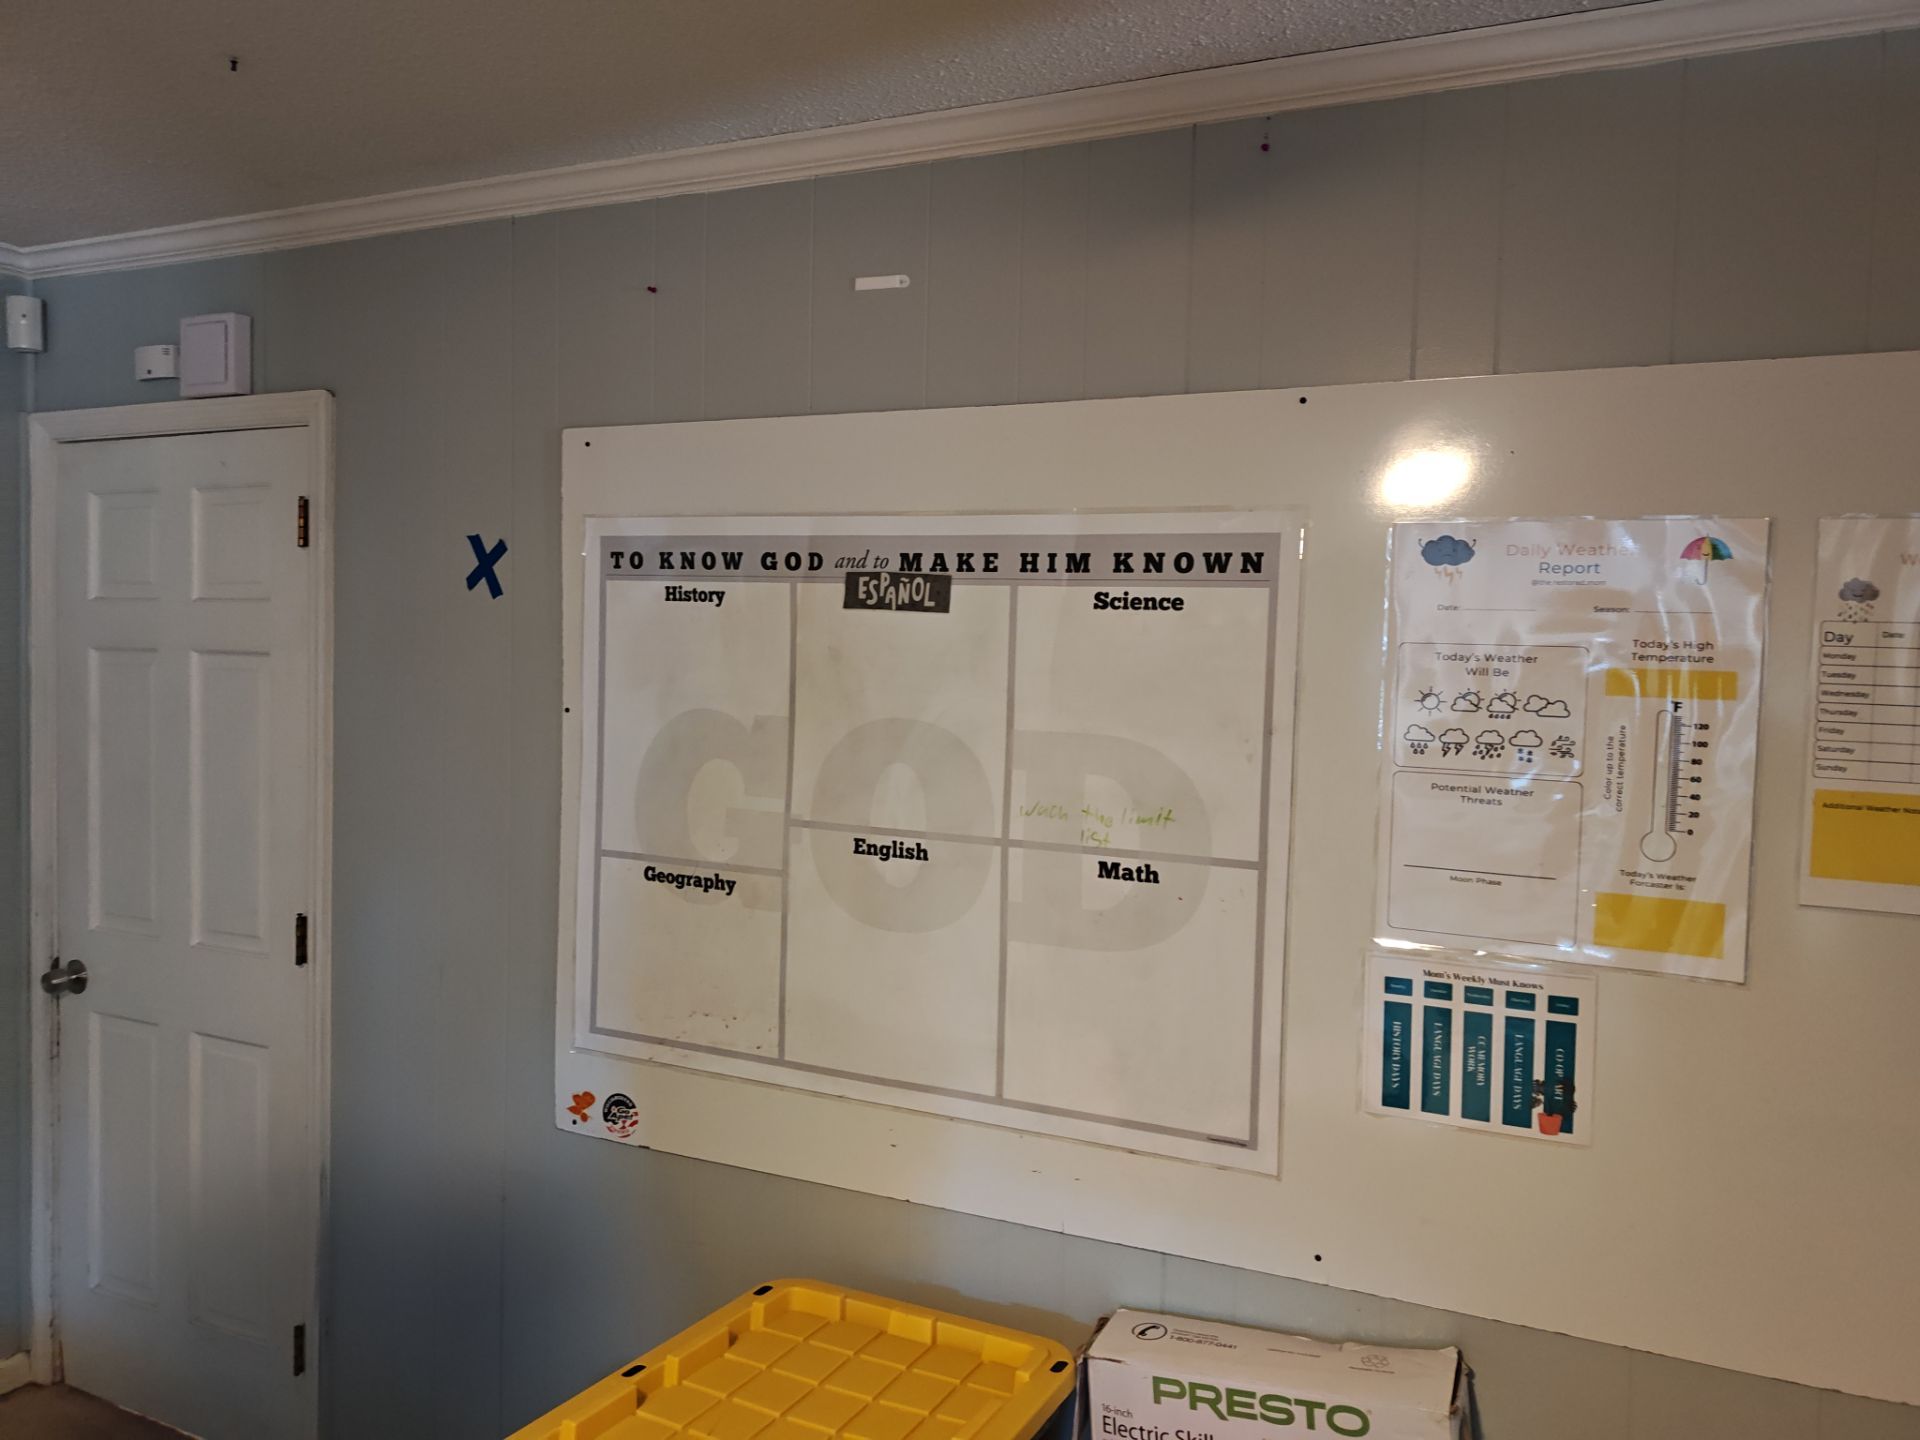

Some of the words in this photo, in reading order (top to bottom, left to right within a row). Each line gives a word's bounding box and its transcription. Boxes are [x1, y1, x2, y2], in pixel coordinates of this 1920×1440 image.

[1506, 544, 1551, 559] Daily
[610, 552, 644, 569] TO
[659, 552, 743, 570] KNOW
[761, 552, 823, 571] GOD
[834, 549, 870, 569] and
[873, 555, 889, 569] to
[899, 552, 999, 573] MAKE
[1019, 552, 1091, 573] HIM
[1113, 551, 1264, 574] KNOWN
[1539, 561, 1601, 576] Report
[664, 586, 726, 607] History
[858, 572, 936, 610] ESPAÑOL
[1093, 591, 1184, 611] Science
[1632, 639, 1681, 650] Today's
[1824, 631, 1854, 645] Day
[1435, 652, 1481, 663] Today's
[1484, 653, 1538, 664] Weather
[1631, 652, 1715, 664] Temperature
[1822, 652, 1856, 661] Monday
[1465, 667, 1490, 676] Will
[1493, 668, 1510, 677] Be
[1822, 670, 1857, 680] Tuesday
[1821, 689, 1870, 699] Wednesday
[1819, 708, 1858, 717] Thursday
[1818, 726, 1845, 736] Friday
[1606, 736, 1614, 750] the
[1817, 745, 1855, 755] Saturday
[1606, 752, 1614, 761] to
[1617, 725, 1626, 779] temperature
[1606, 766, 1614, 775] up
[1816, 763, 1848, 773] Sunday
[1431, 783, 1481, 794] Potential
[1485, 786, 1534, 797] Weather
[1603, 778, 1613, 800] Color
[1616, 782, 1624, 812] correct
[1460, 795, 1503, 806] Threats
[853, 838, 929, 862] English
[643, 866, 737, 895] Geography
[1098, 861, 1160, 884] Math
[1450, 875, 1473, 883] Moon
[1476, 877, 1502, 886] Phase
[1618, 869, 1654, 879] Today's
[1656, 873, 1697, 882] Weather
[1423, 969, 1451, 980] Mom's
[1453, 973, 1485, 985] Weekly
[1489, 977, 1510, 987] Must
[1512, 980, 1544, 990] Knows
[1391, 1021, 1402, 1061] HISTORY
[1433, 1022, 1443, 1069] LANGUAGE
[1467, 1046, 1476, 1072] WORK
[1513, 1034, 1524, 1082] LANGUAGE
[1391, 1064, 1401, 1088] DAYS
[1476, 1050, 1486, 1086] MEMORY
[1432, 1072, 1442, 1096] DAYS
[1512, 1085, 1522, 1110] DAYS
[1102, 1403, 1134, 1419] 16-inch
[1152, 1375, 1370, 1438] PRESTO
[1103, 1415, 1169, 1440] Electric
